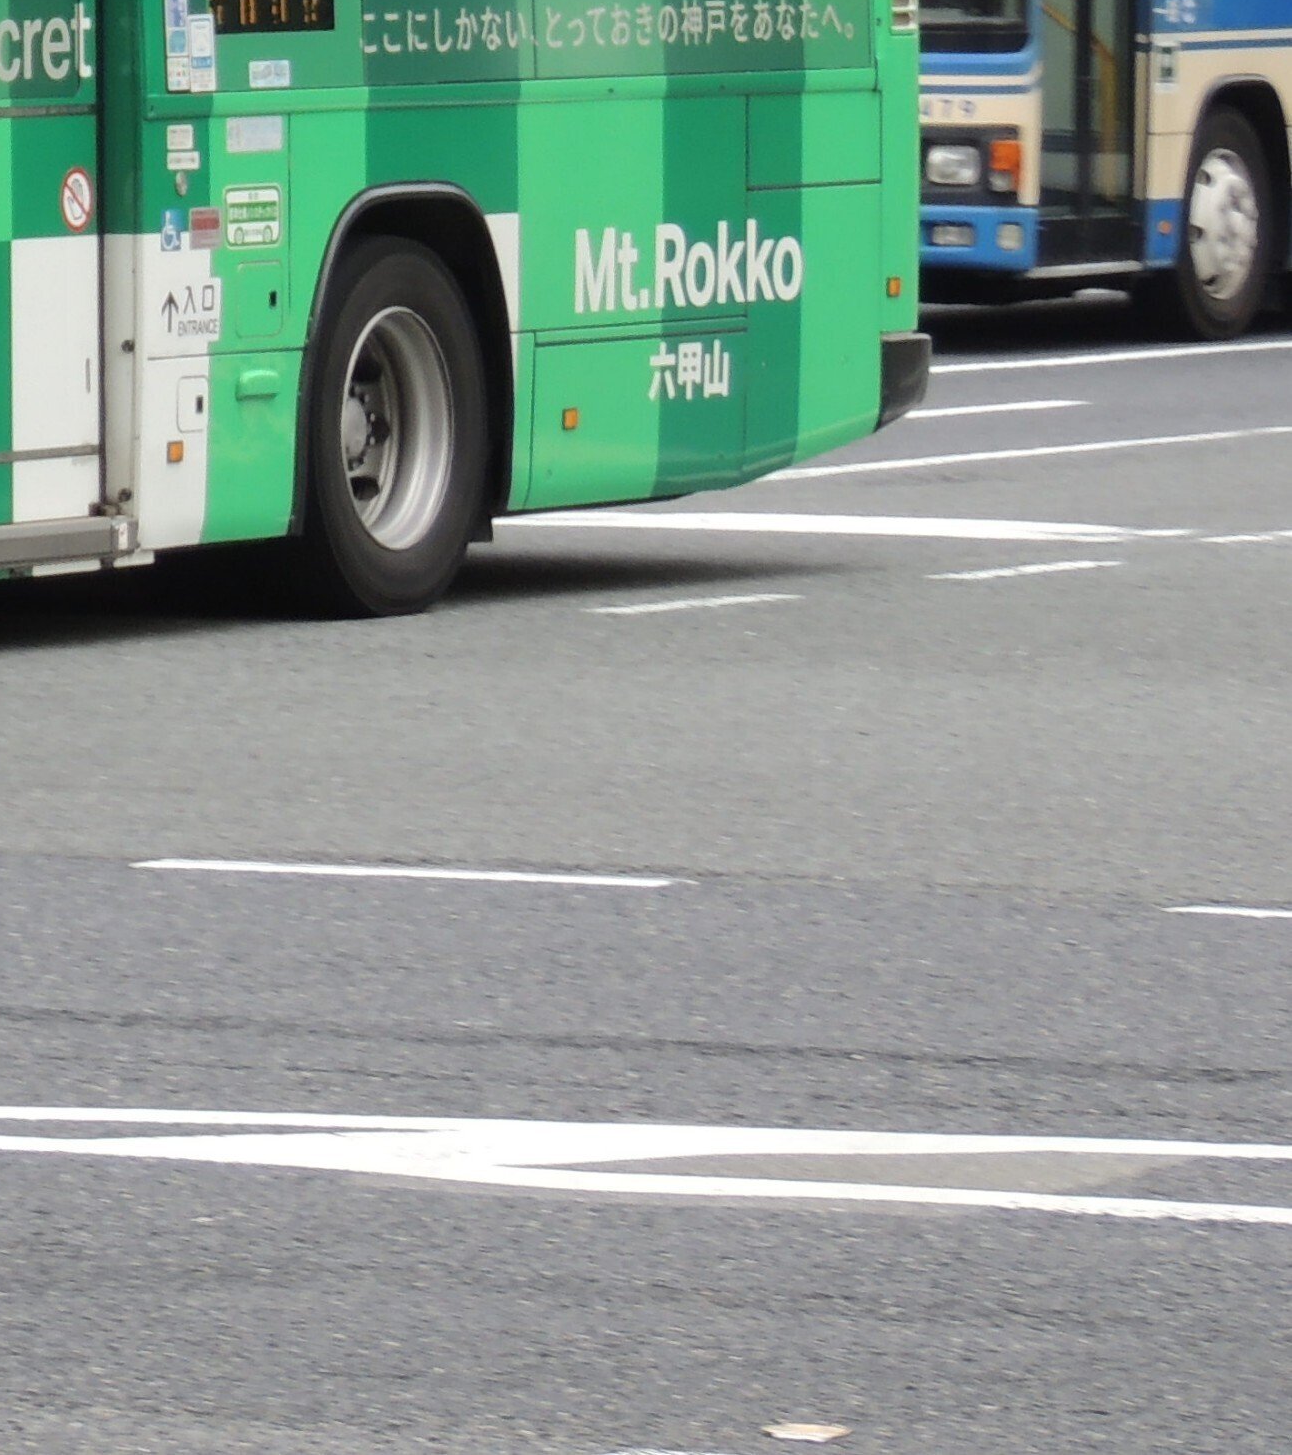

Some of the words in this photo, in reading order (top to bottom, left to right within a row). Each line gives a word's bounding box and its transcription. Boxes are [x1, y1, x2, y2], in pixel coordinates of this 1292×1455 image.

[574, 218, 805, 314] Mt.Rokko
[182, 284, 215, 314] 入口
[177, 319, 220, 337] ENTRANCE
[648, 340, 730, 401] 六甲山
